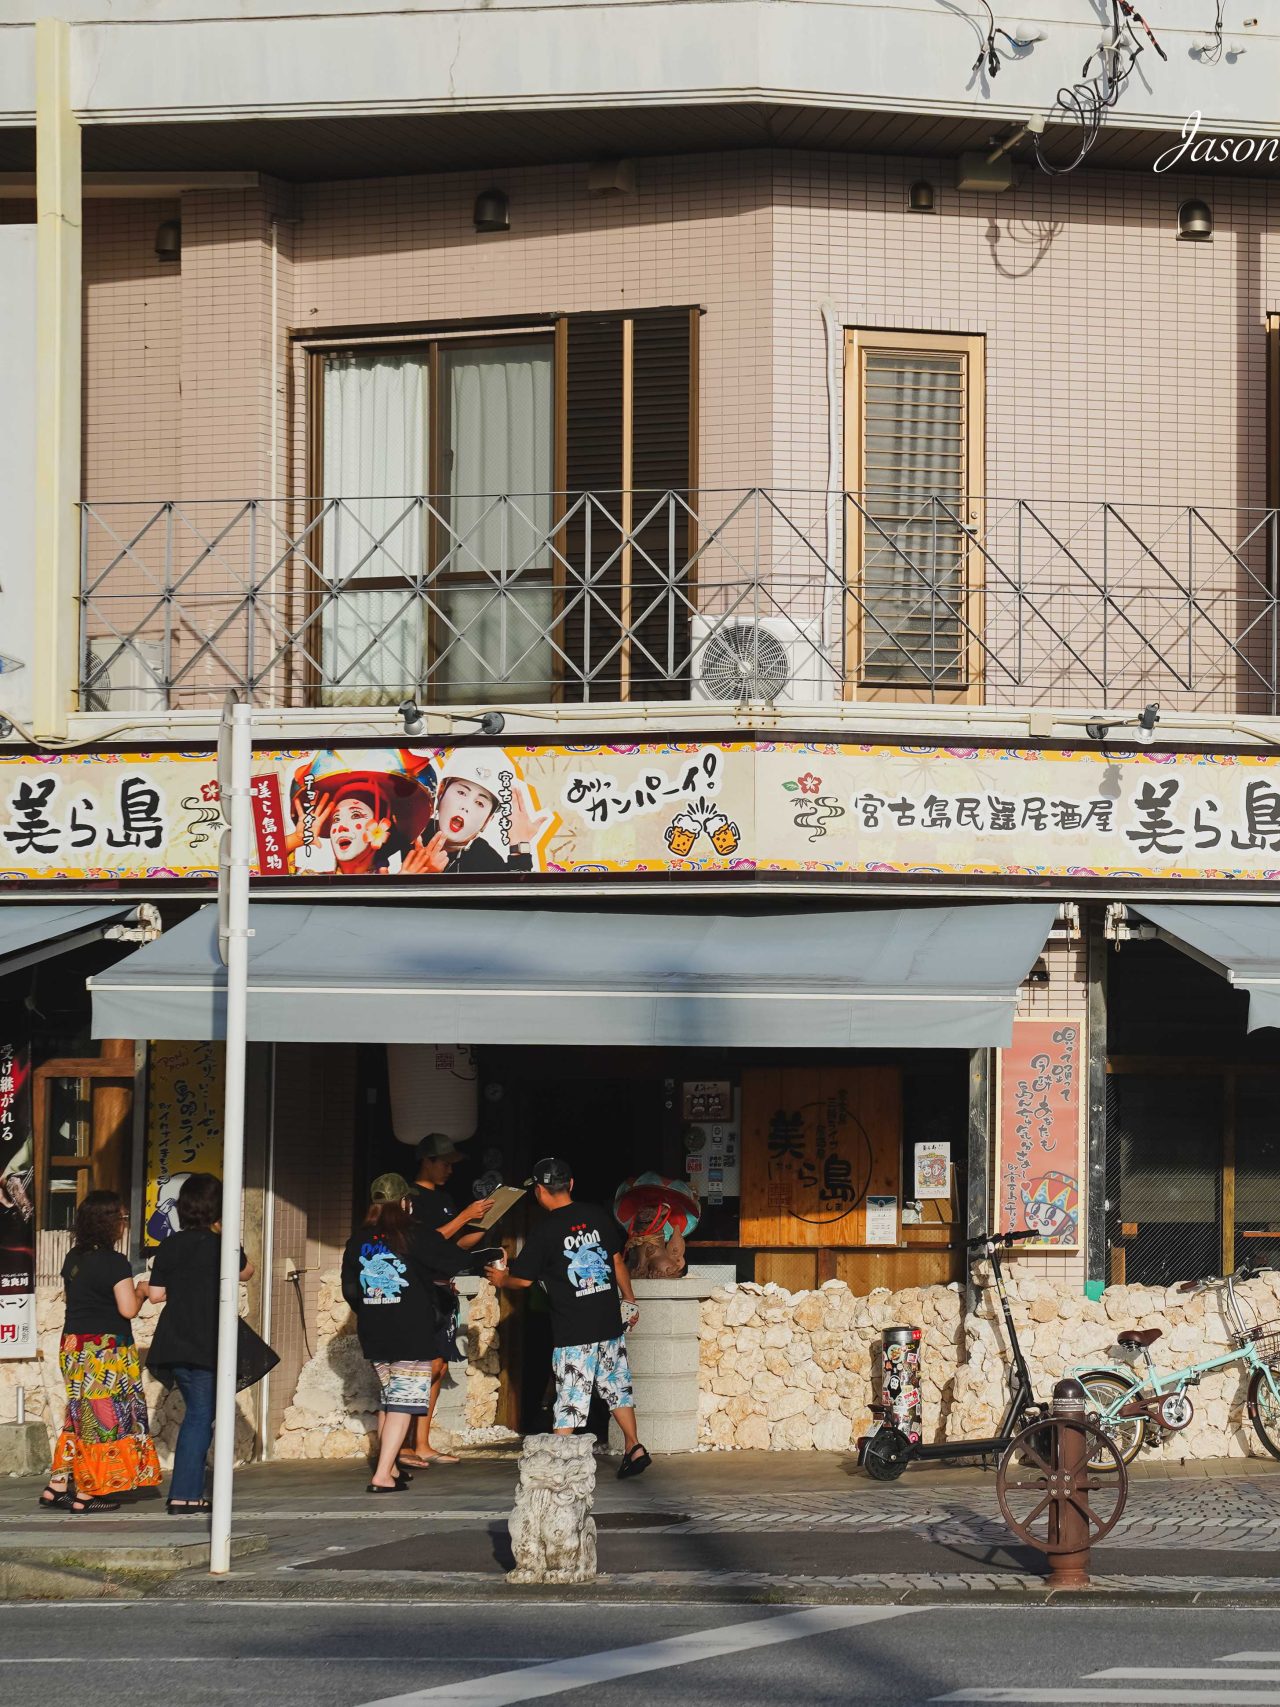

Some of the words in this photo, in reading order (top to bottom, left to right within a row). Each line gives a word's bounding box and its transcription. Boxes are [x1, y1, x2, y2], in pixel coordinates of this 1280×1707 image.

[3, 776, 164, 854] 美ら島
[257, 780, 284, 870] 美ら島名物
[303, 773, 317, 858] チョンダラー
[498, 769, 514, 847] 宮古まもる
[0, 1043, 15, 1142] 受け継がれる
[563, 1229, 602, 1250] Orion
